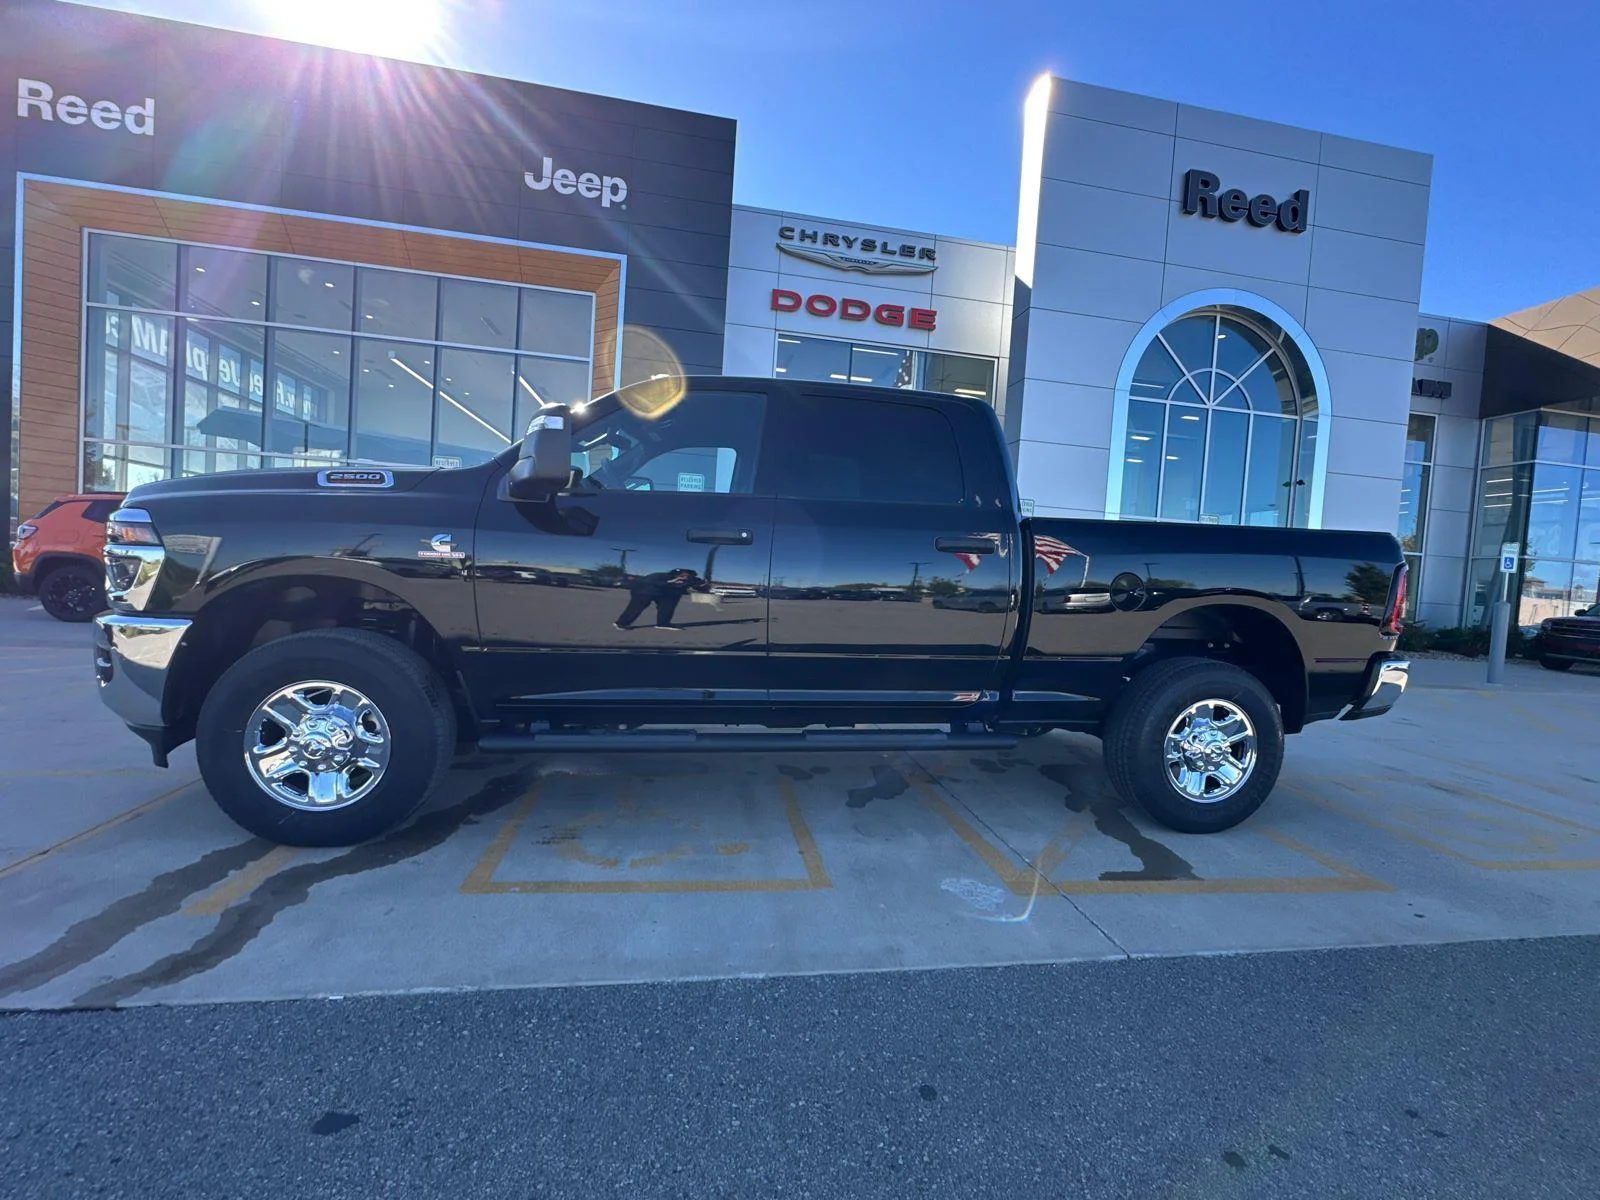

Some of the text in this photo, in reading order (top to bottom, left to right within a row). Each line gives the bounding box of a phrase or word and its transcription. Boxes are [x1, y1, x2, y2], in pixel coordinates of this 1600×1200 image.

[17, 78, 155, 136] Reed
[524, 157, 628, 208] Jeep
[1183, 168, 1310, 234] Reed
[778, 226, 937, 261] CHRYSLER
[770, 288, 937, 331] DODGE
